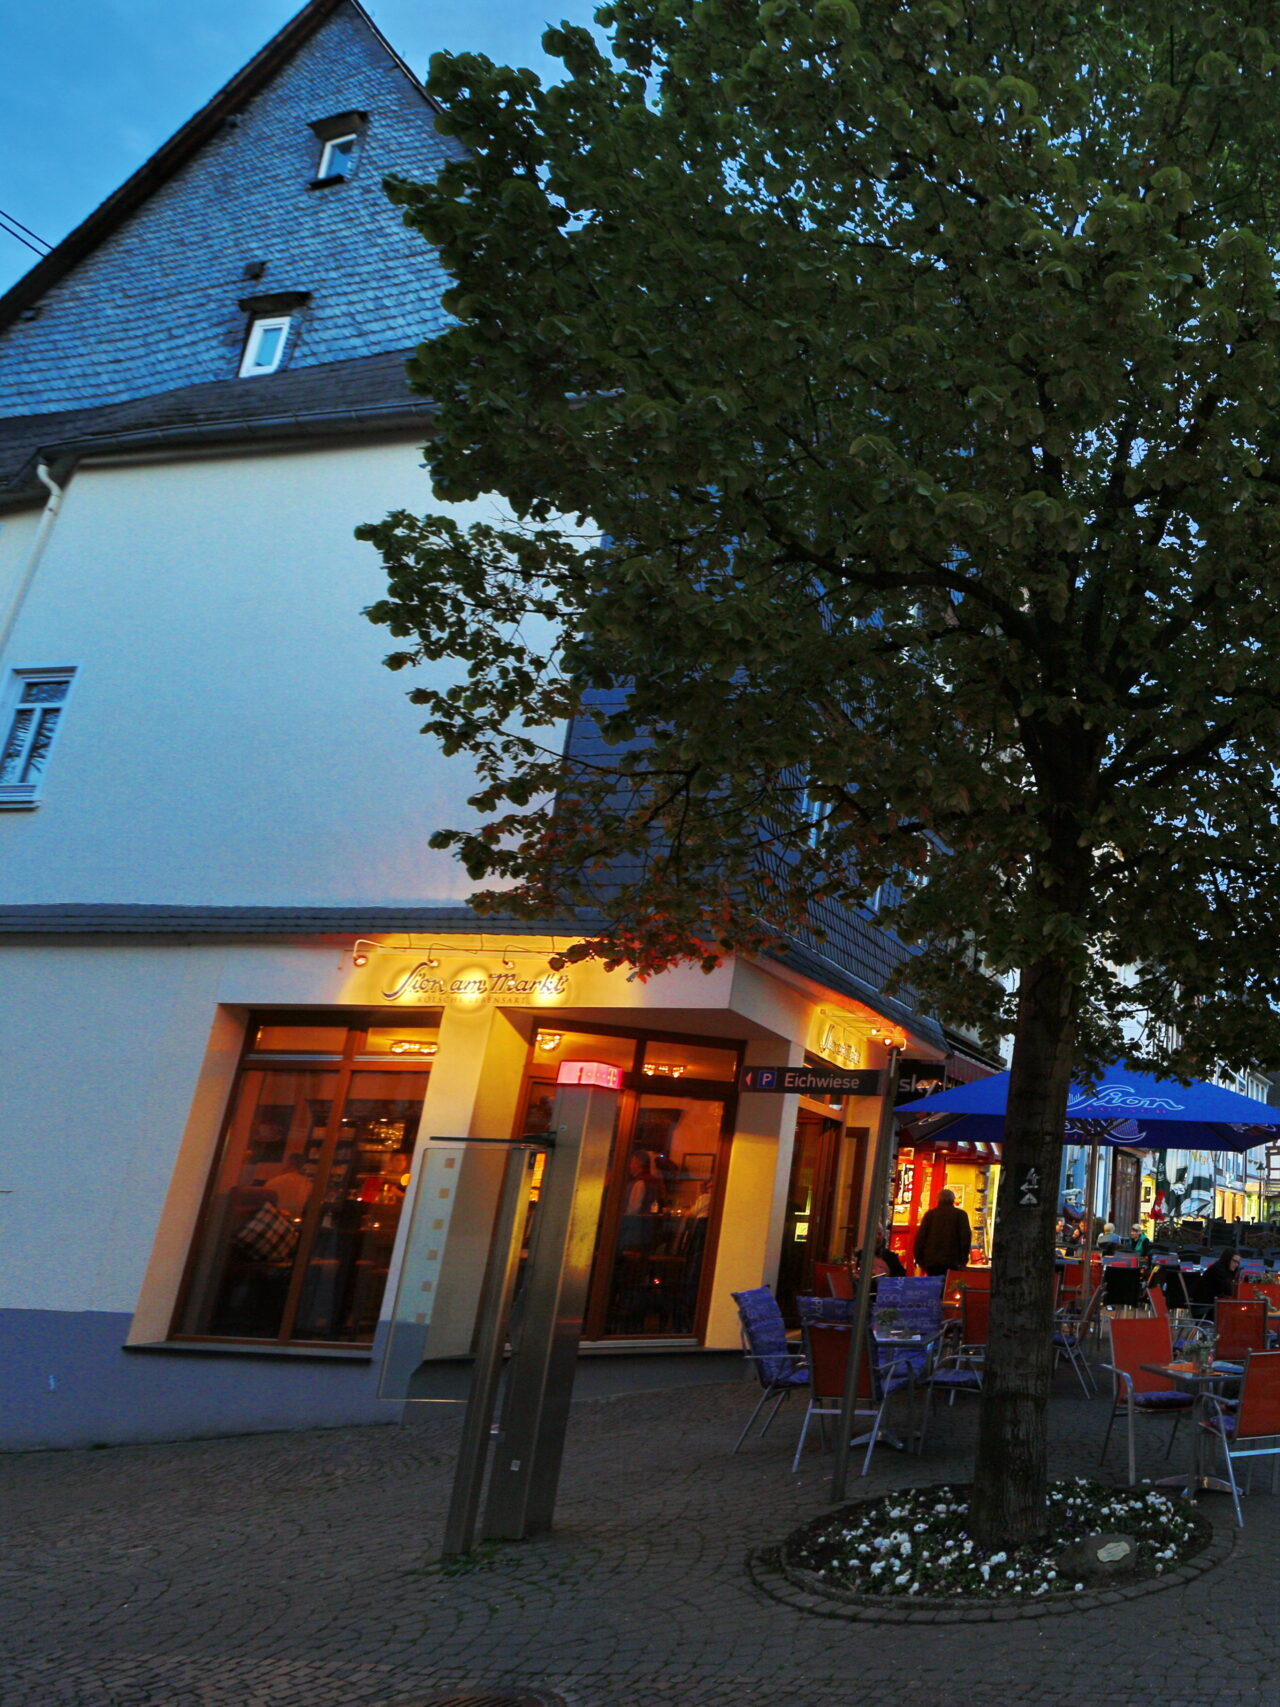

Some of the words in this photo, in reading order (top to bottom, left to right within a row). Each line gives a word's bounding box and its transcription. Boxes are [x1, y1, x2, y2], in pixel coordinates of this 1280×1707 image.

[382, 961, 445, 999] Sion
[450, 978, 488, 993] am
[488, 972, 569, 994] Markt
[784, 1072, 860, 1089] Eichwiese
